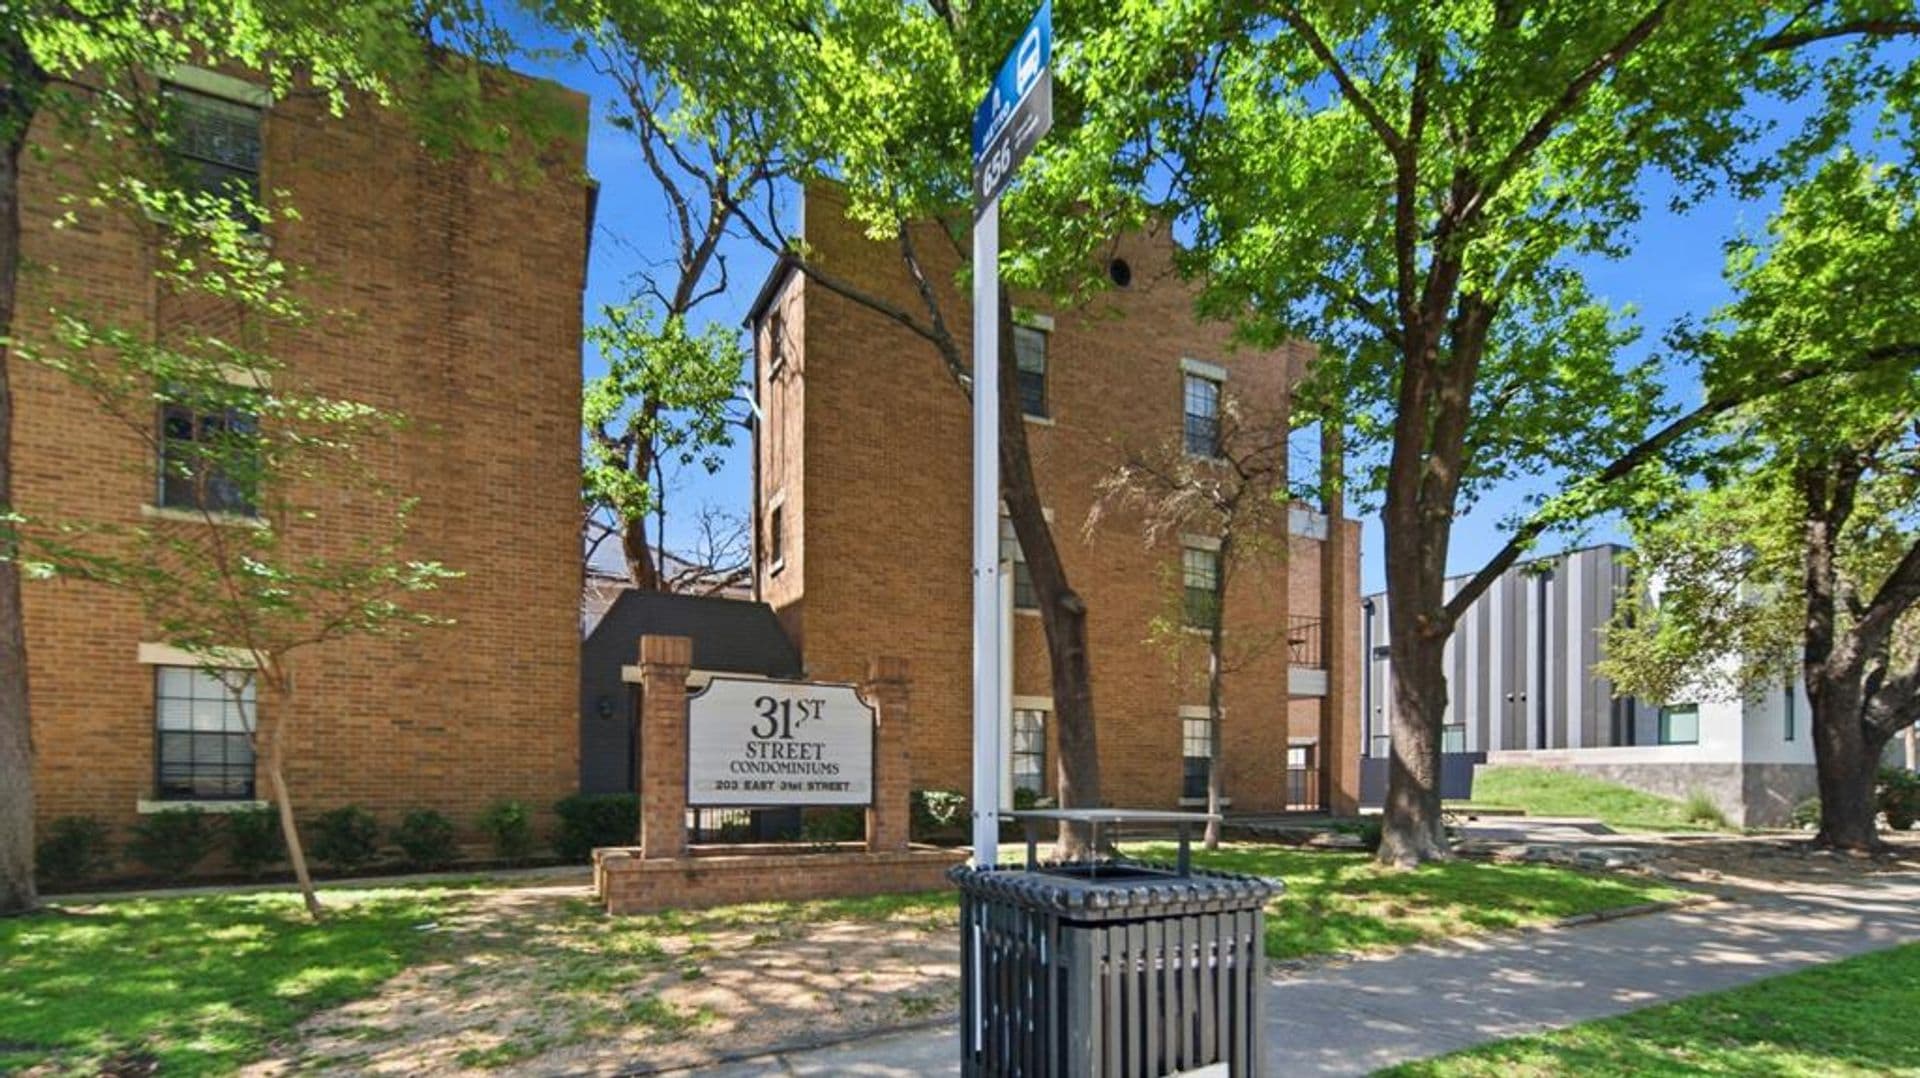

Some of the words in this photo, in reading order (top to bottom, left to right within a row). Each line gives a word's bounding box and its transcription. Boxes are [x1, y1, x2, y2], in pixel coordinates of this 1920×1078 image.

[983, 137, 1011, 197] 656
[745, 741, 826, 761] STREET
[730, 760, 840, 776] CONDOMINIUMS
[715, 780, 739, 791] 203
[744, 780, 775, 791] EAST
[807, 780, 850, 791] STREET
